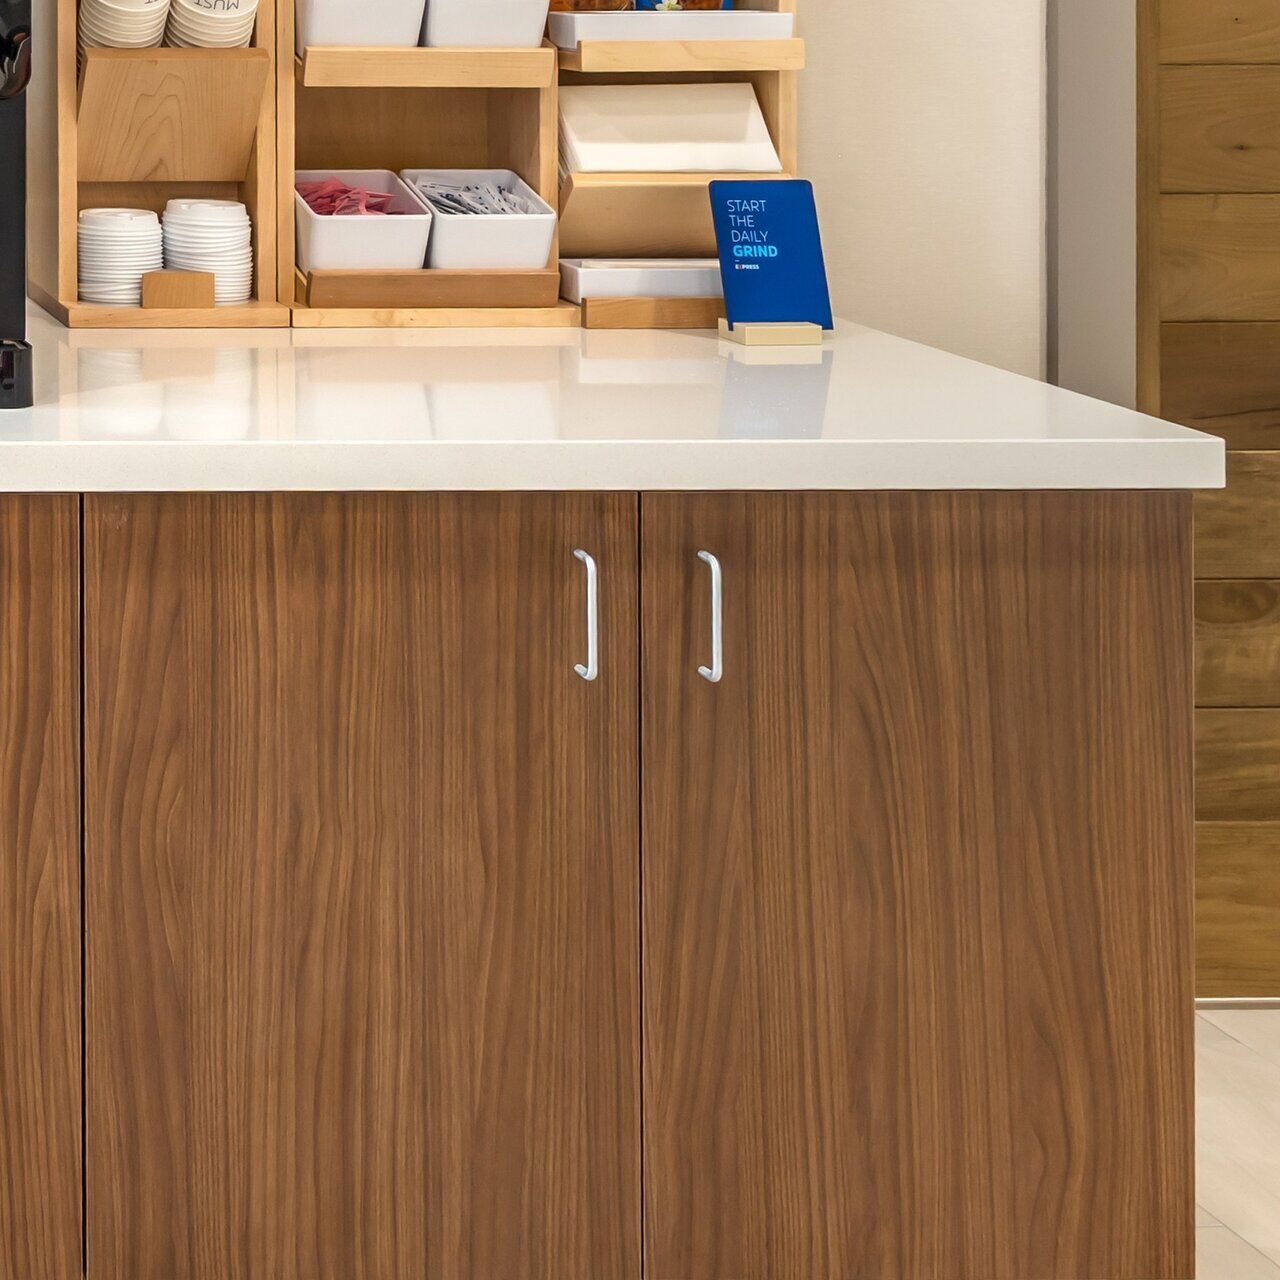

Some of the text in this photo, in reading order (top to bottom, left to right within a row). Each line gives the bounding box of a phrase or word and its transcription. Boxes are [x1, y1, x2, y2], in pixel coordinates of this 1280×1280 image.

[727, 199, 767, 212] START
[728, 214, 755, 228] THE
[731, 229, 769, 242] DAILY
[732, 245, 778, 257] GRIND
